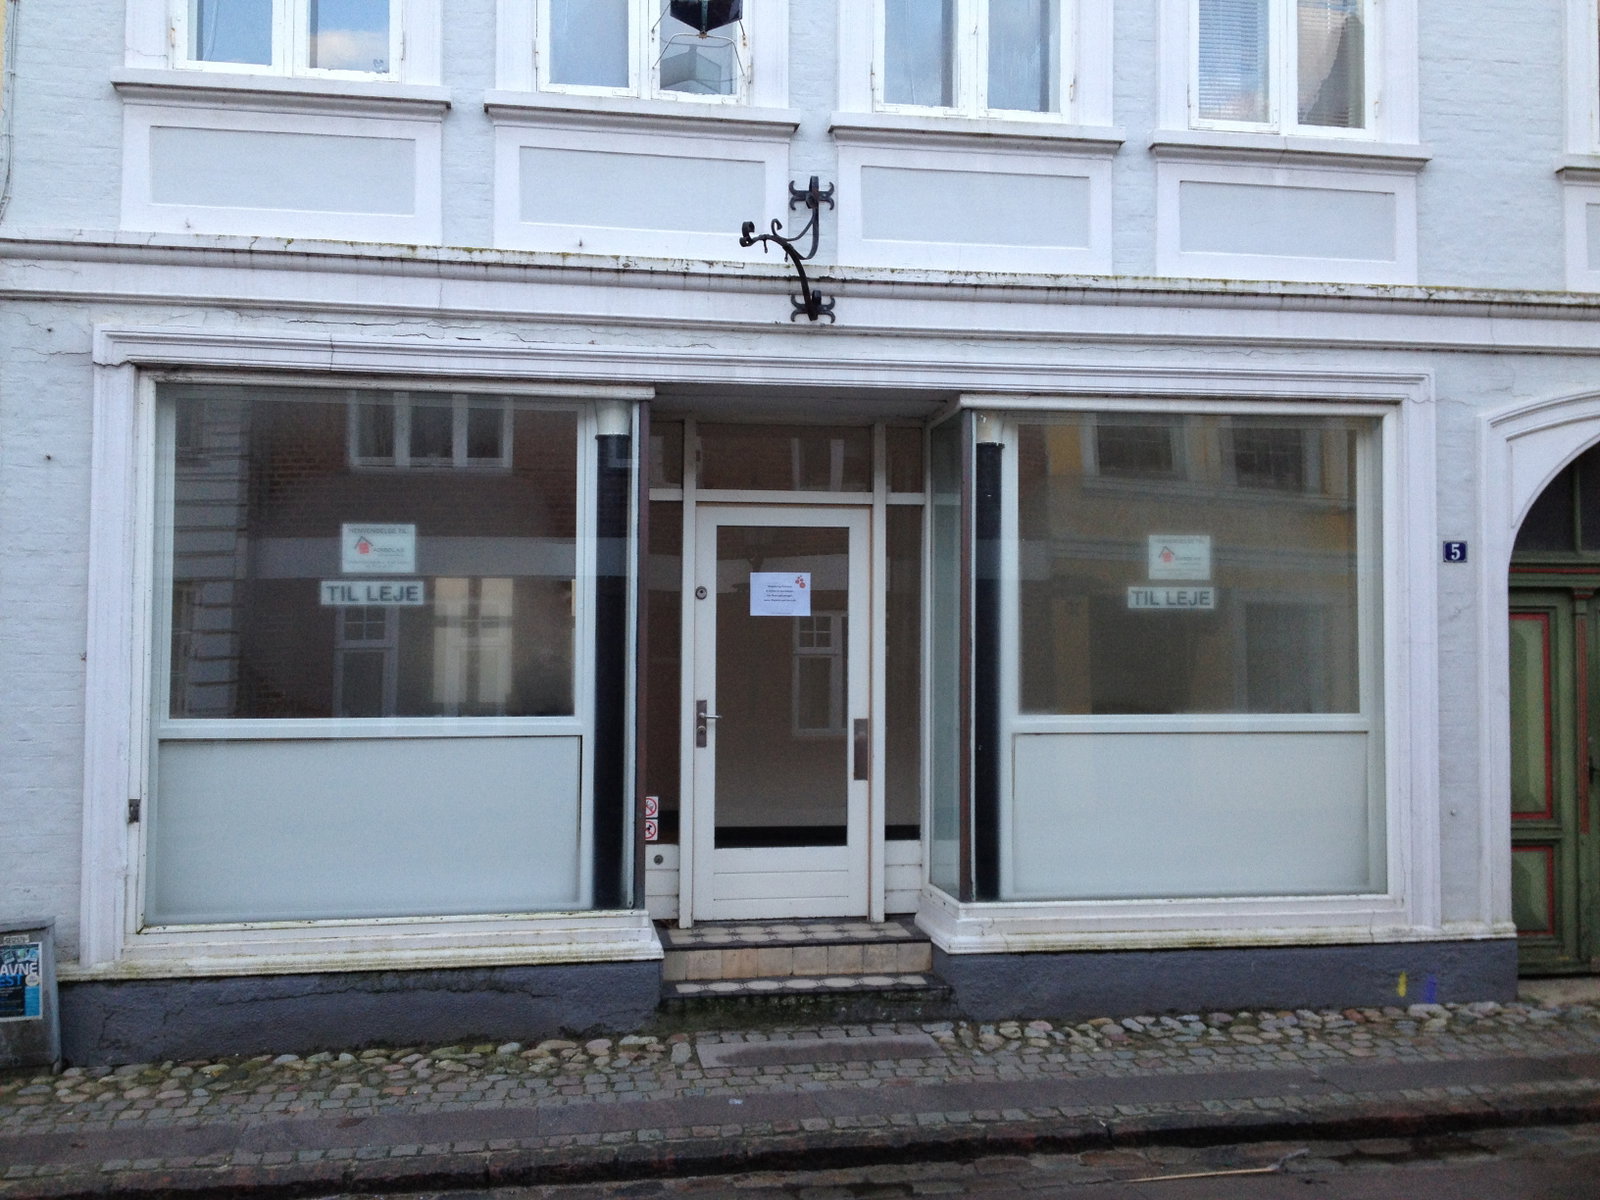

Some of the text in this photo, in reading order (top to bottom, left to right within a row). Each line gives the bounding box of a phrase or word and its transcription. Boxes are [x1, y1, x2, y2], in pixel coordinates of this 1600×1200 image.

[1451, 543, 1461, 560] 5
[326, 586, 419, 602] TIL LEJE
[1131, 591, 1211, 606] TIL LEJE
